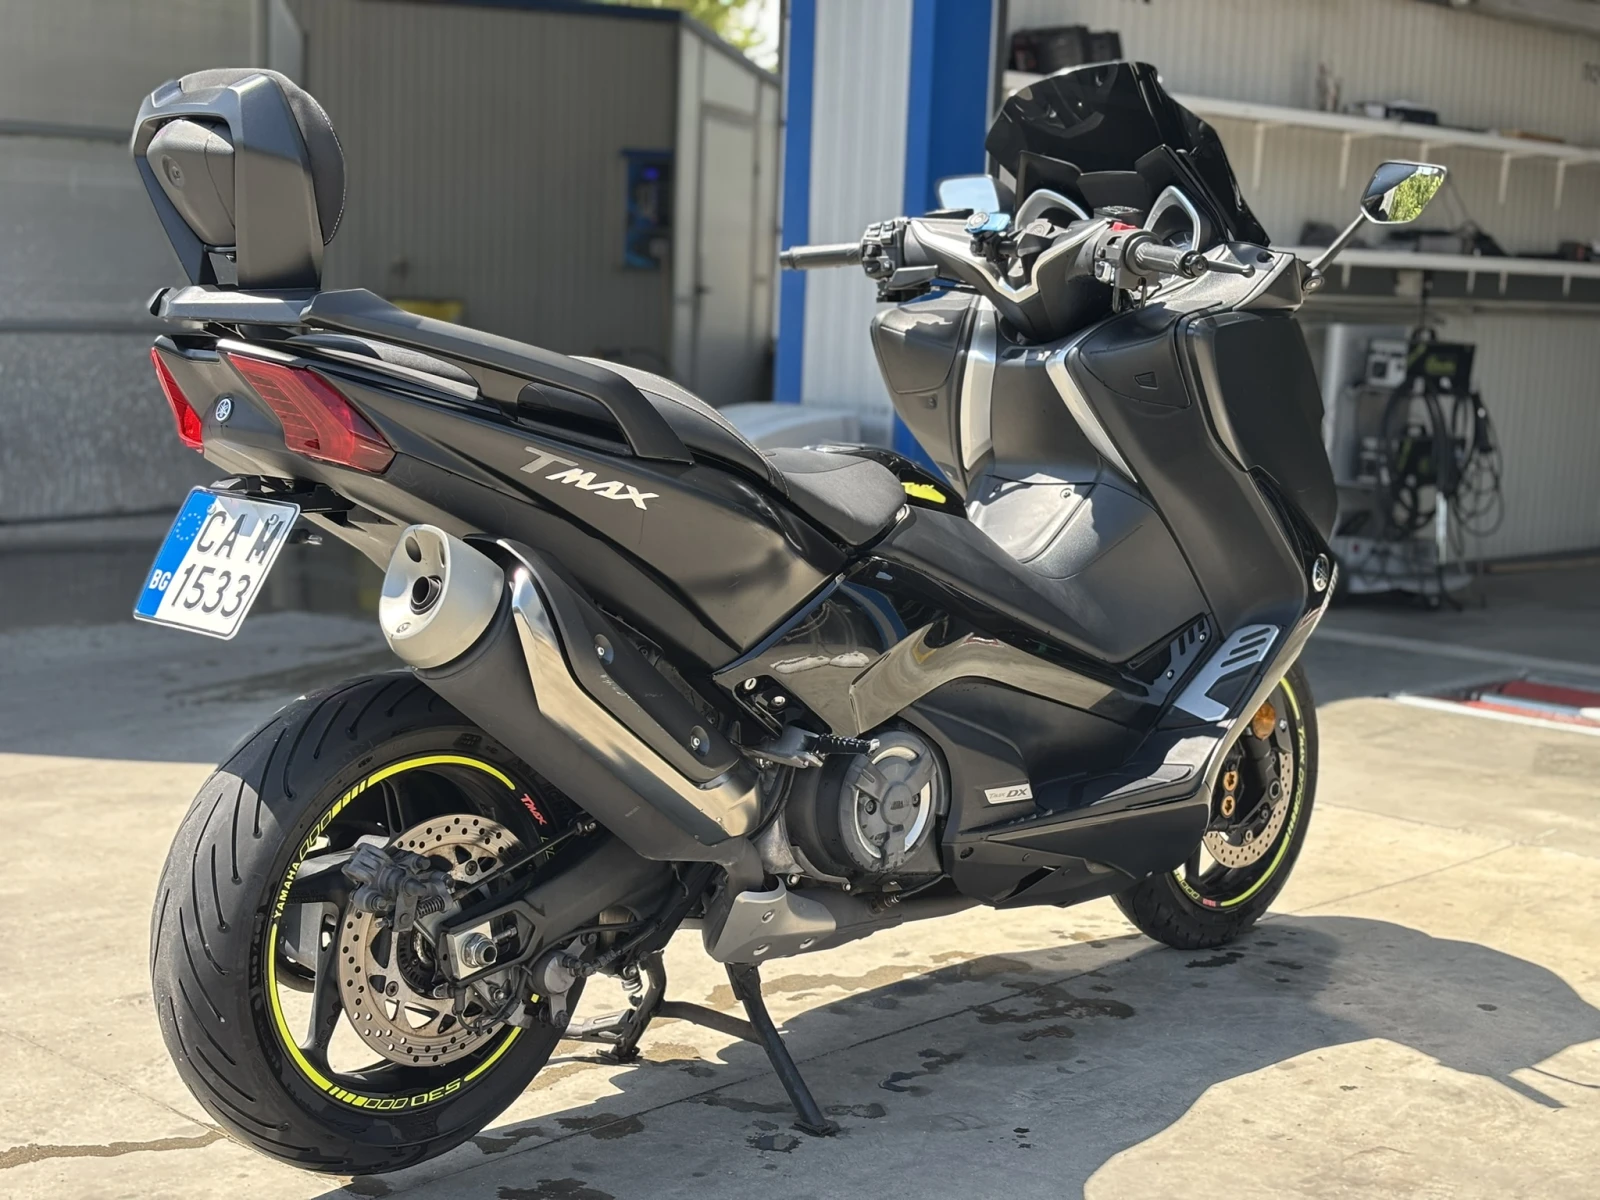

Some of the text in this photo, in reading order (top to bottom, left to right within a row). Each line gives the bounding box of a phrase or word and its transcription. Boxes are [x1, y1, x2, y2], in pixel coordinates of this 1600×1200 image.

[520, 446, 660, 510] TMAX
[196, 511, 287, 565] CA M
[149, 569, 171, 591] BG
[171, 563, 251, 617] 1533
[1006, 788, 1028, 798] DX
[274, 861, 300, 919] YAMAHA
